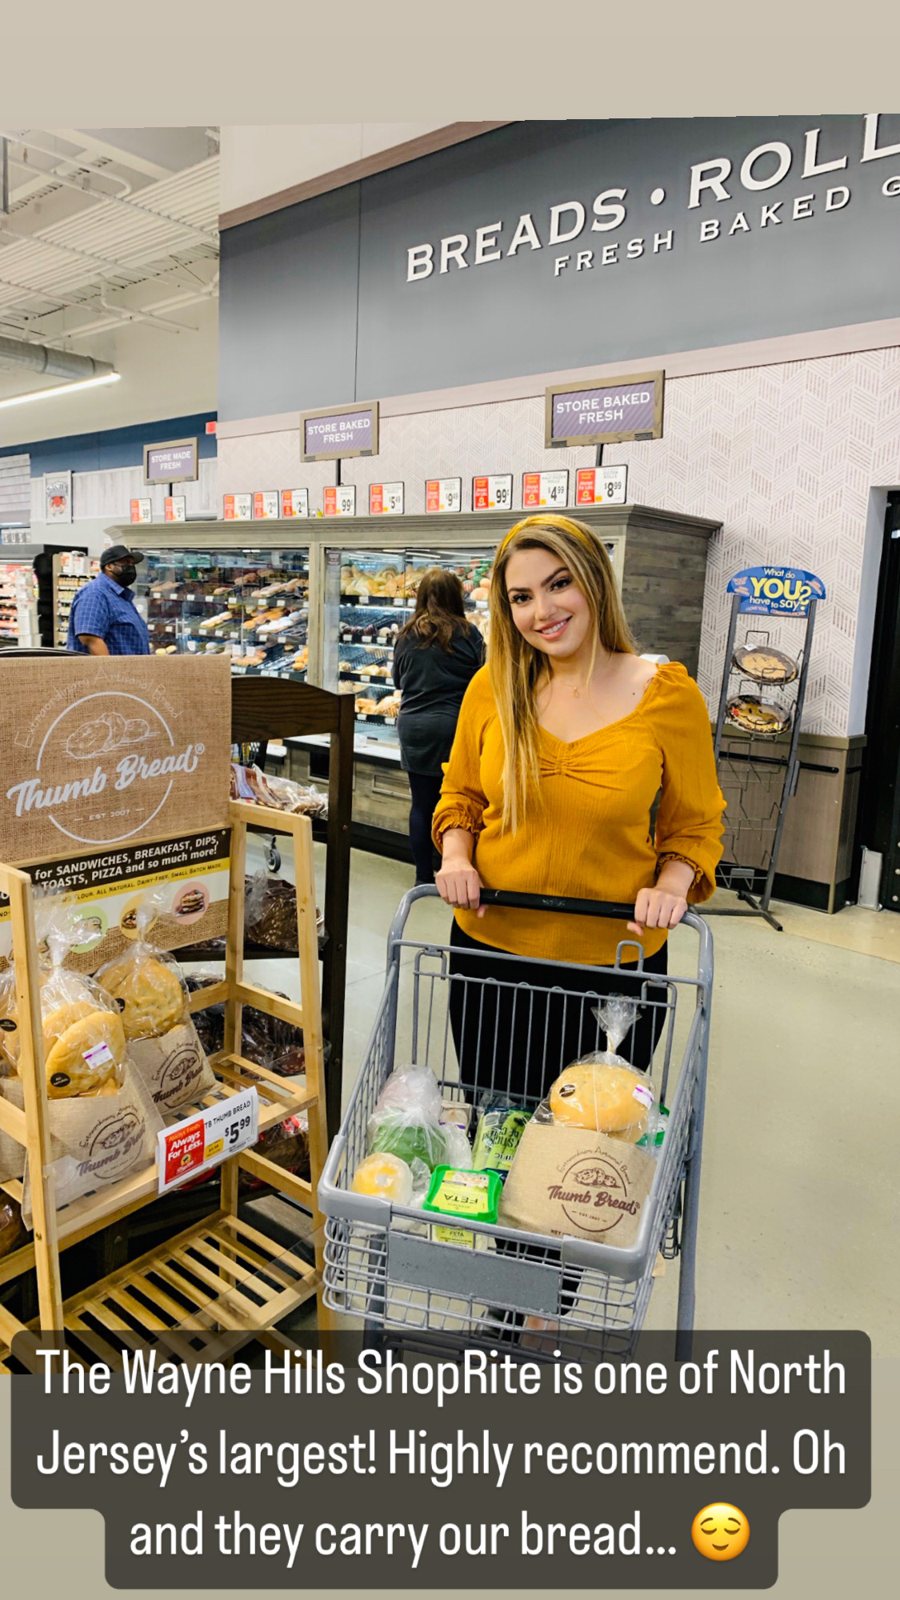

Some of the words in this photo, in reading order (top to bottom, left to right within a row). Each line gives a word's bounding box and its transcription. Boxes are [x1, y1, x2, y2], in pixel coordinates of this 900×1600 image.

[405, 188, 627, 282] BREADS
[553, 229, 674, 277] FRESH
[699, 185, 852, 242] BAKED
[556, 397, 599, 414] STORE
[603, 391, 650, 407] BAKED
[307, 421, 337, 435] STORE
[339, 418, 370, 432] BAKED
[579, 408, 623, 424] FRESH
[323, 430, 354, 444] FRESH
[151, 453, 172, 463] STORE
[172, 450, 191, 460] MADE
[160, 461, 181, 470] FRESH
[763, 567, 785, 577] What
[749, 595, 771, 605] have
[6, 766, 106, 817] Thumb
[35, 868, 53, 881] for
[56, 853, 131, 877] SANDWICHES,
[134, 840, 193, 860] BREAKFAST,
[195, 835, 219, 848] DIPS,
[41, 874, 88, 891] TOASTS,
[91, 865, 123, 881] PIZZA
[125, 861, 145, 873] and
[147, 859, 159, 869] so
[161, 851, 188, 866] much
[190, 845, 218, 859] more!
[213, 1109, 232, 1125] THUMB
[232, 1100, 251, 1115] BREAD
[167, 1148, 182, 1162] For
[183, 1140, 203, 1154] Less.
[170, 1130, 201, 1152] Always
[76, 1149, 120, 1177] Thumb
[444, 1193, 479, 1204] FETA
[547, 1185, 592, 1204] Thumb
